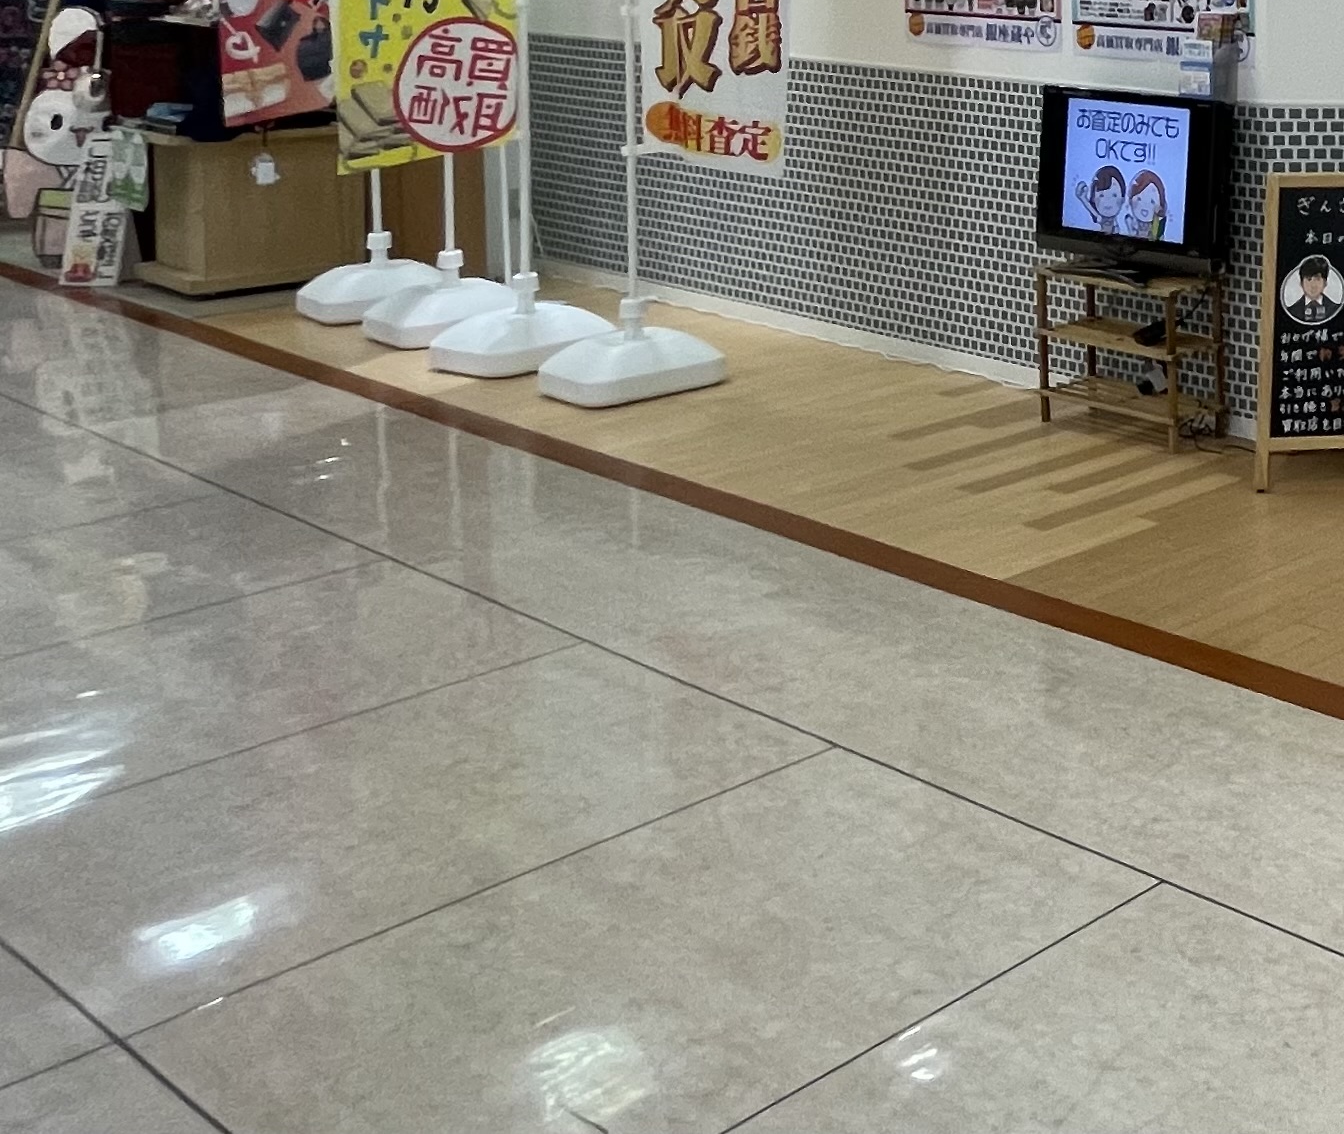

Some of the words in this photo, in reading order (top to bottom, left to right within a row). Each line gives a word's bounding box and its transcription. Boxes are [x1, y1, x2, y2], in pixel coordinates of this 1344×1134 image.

[1076, 108, 1181, 139] お査定のみても
